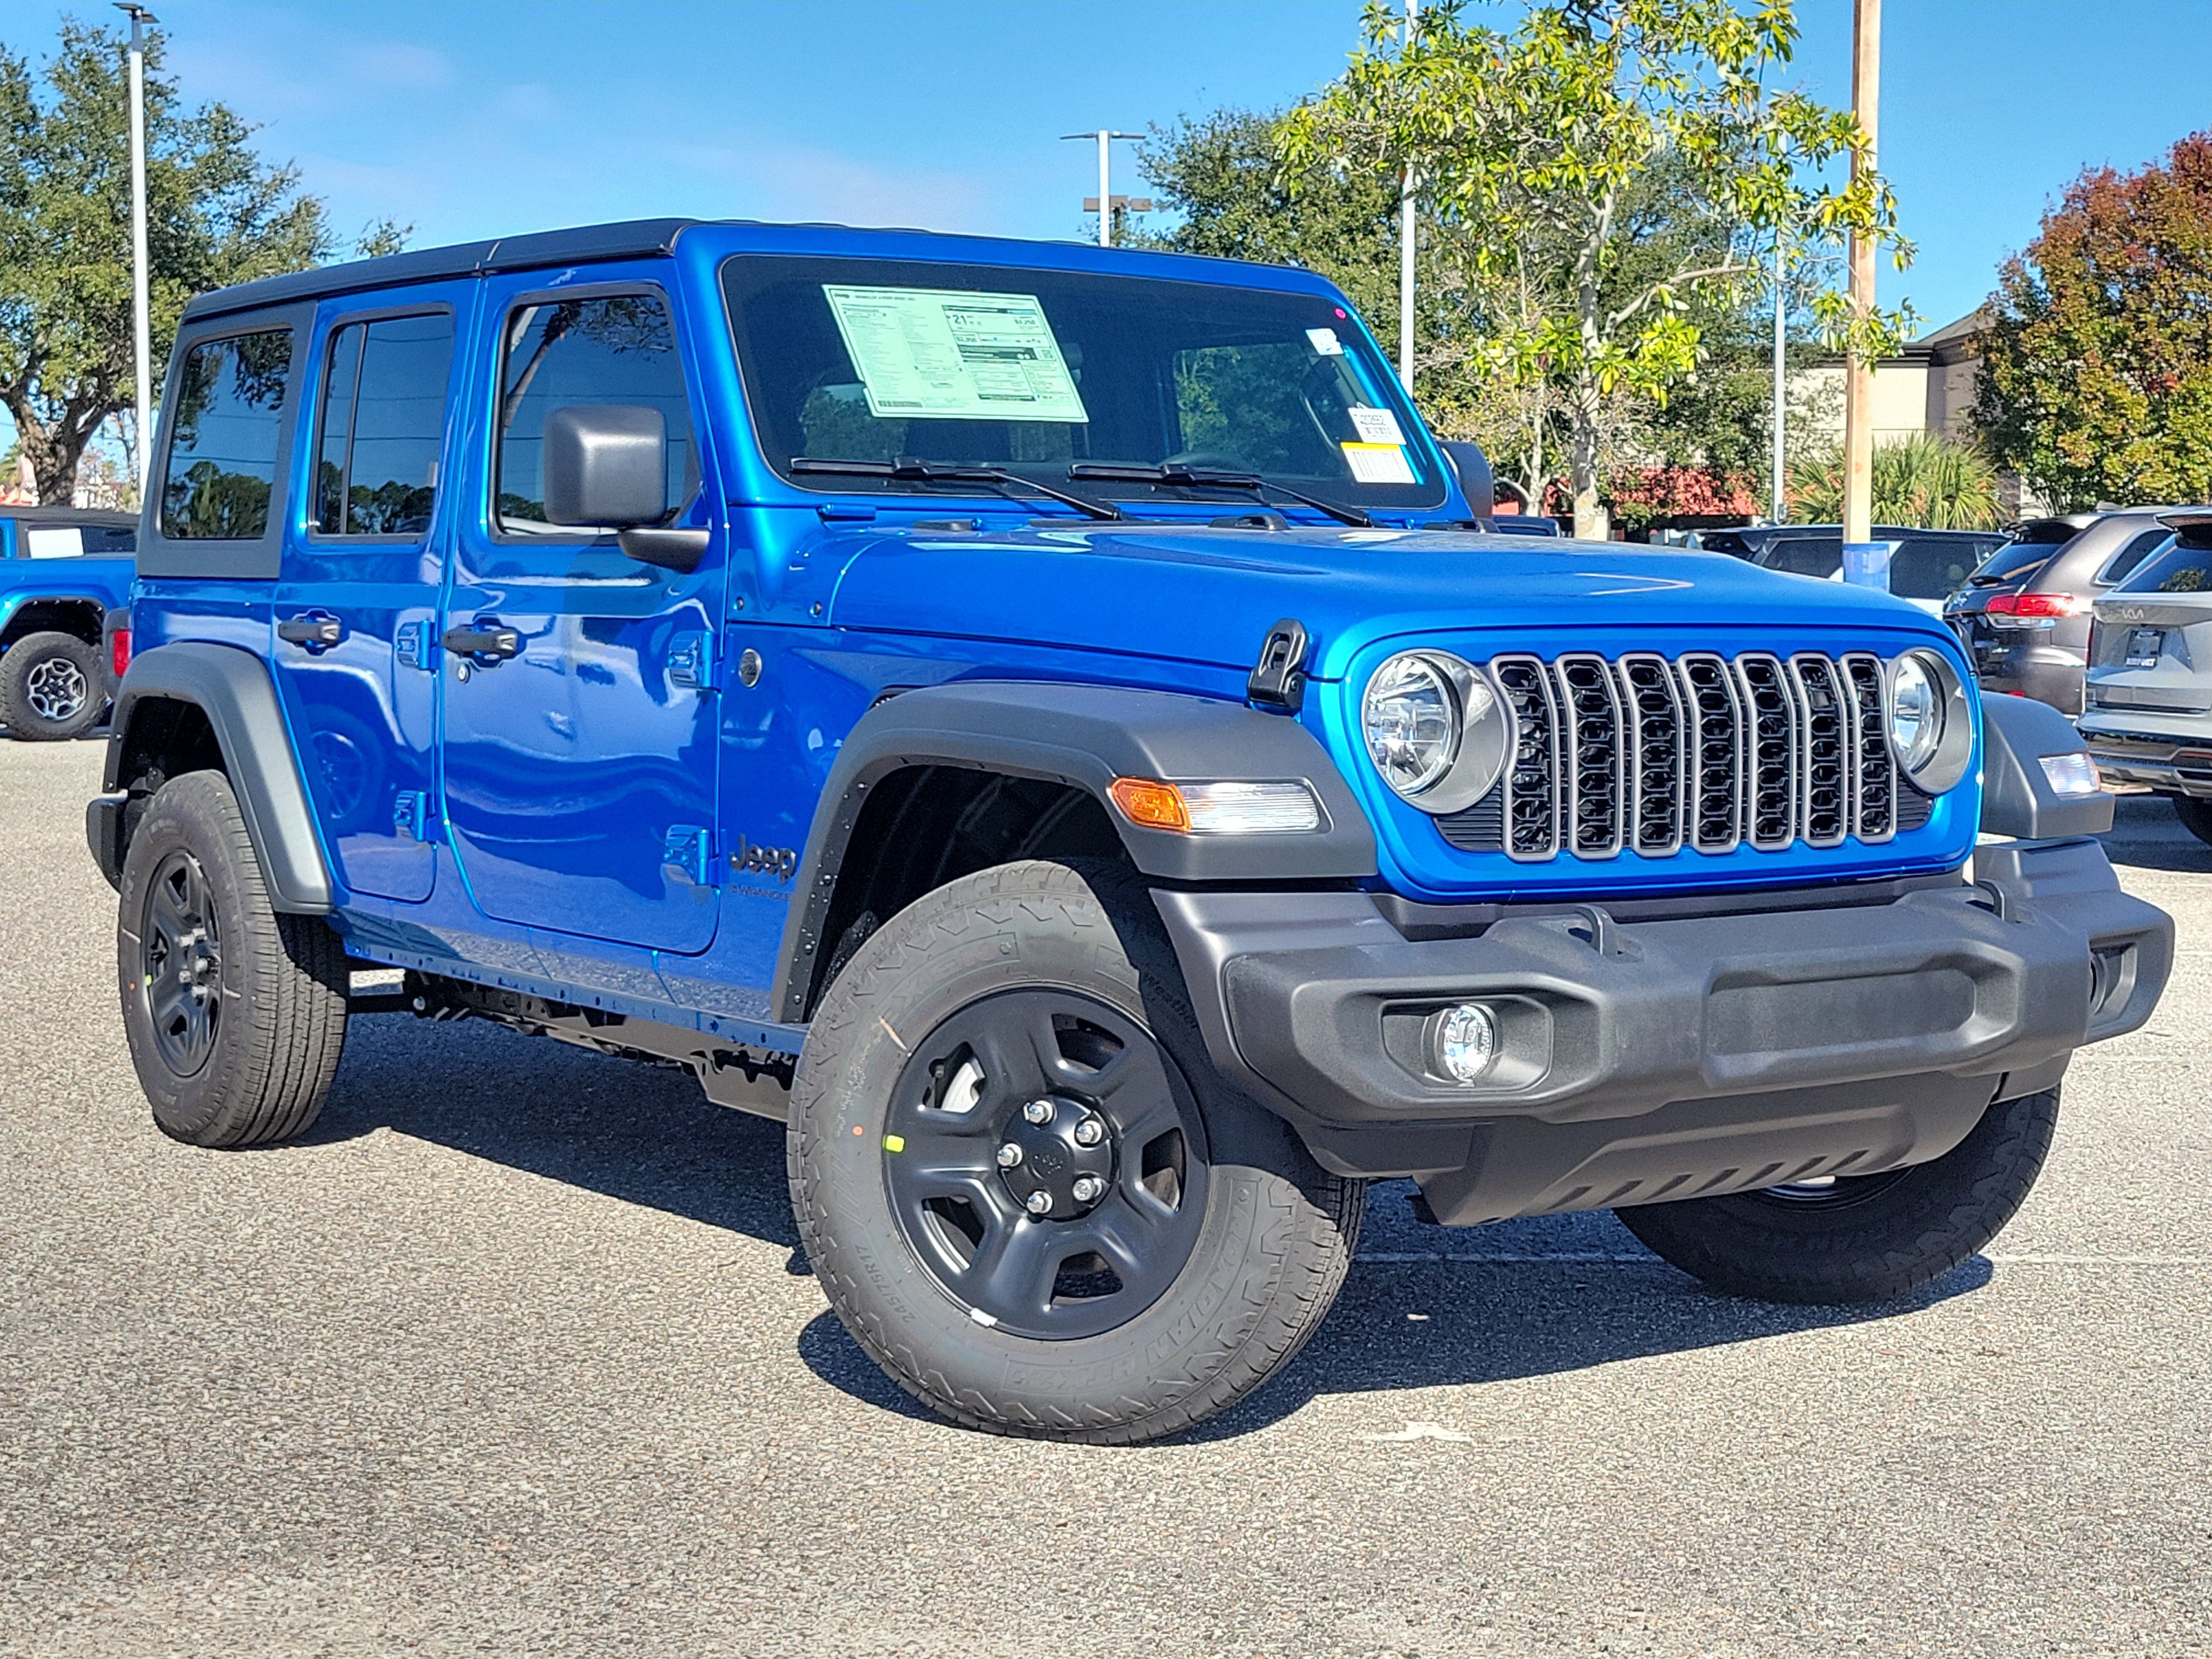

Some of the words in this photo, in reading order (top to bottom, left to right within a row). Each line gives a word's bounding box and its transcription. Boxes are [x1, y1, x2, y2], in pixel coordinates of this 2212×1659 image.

[952, 315, 967, 324] 21
[730, 834, 796, 884] Jeep
[854, 1244, 917, 1324] 245/75R17
[1142, 1205, 1252, 1367] ROADIAN
